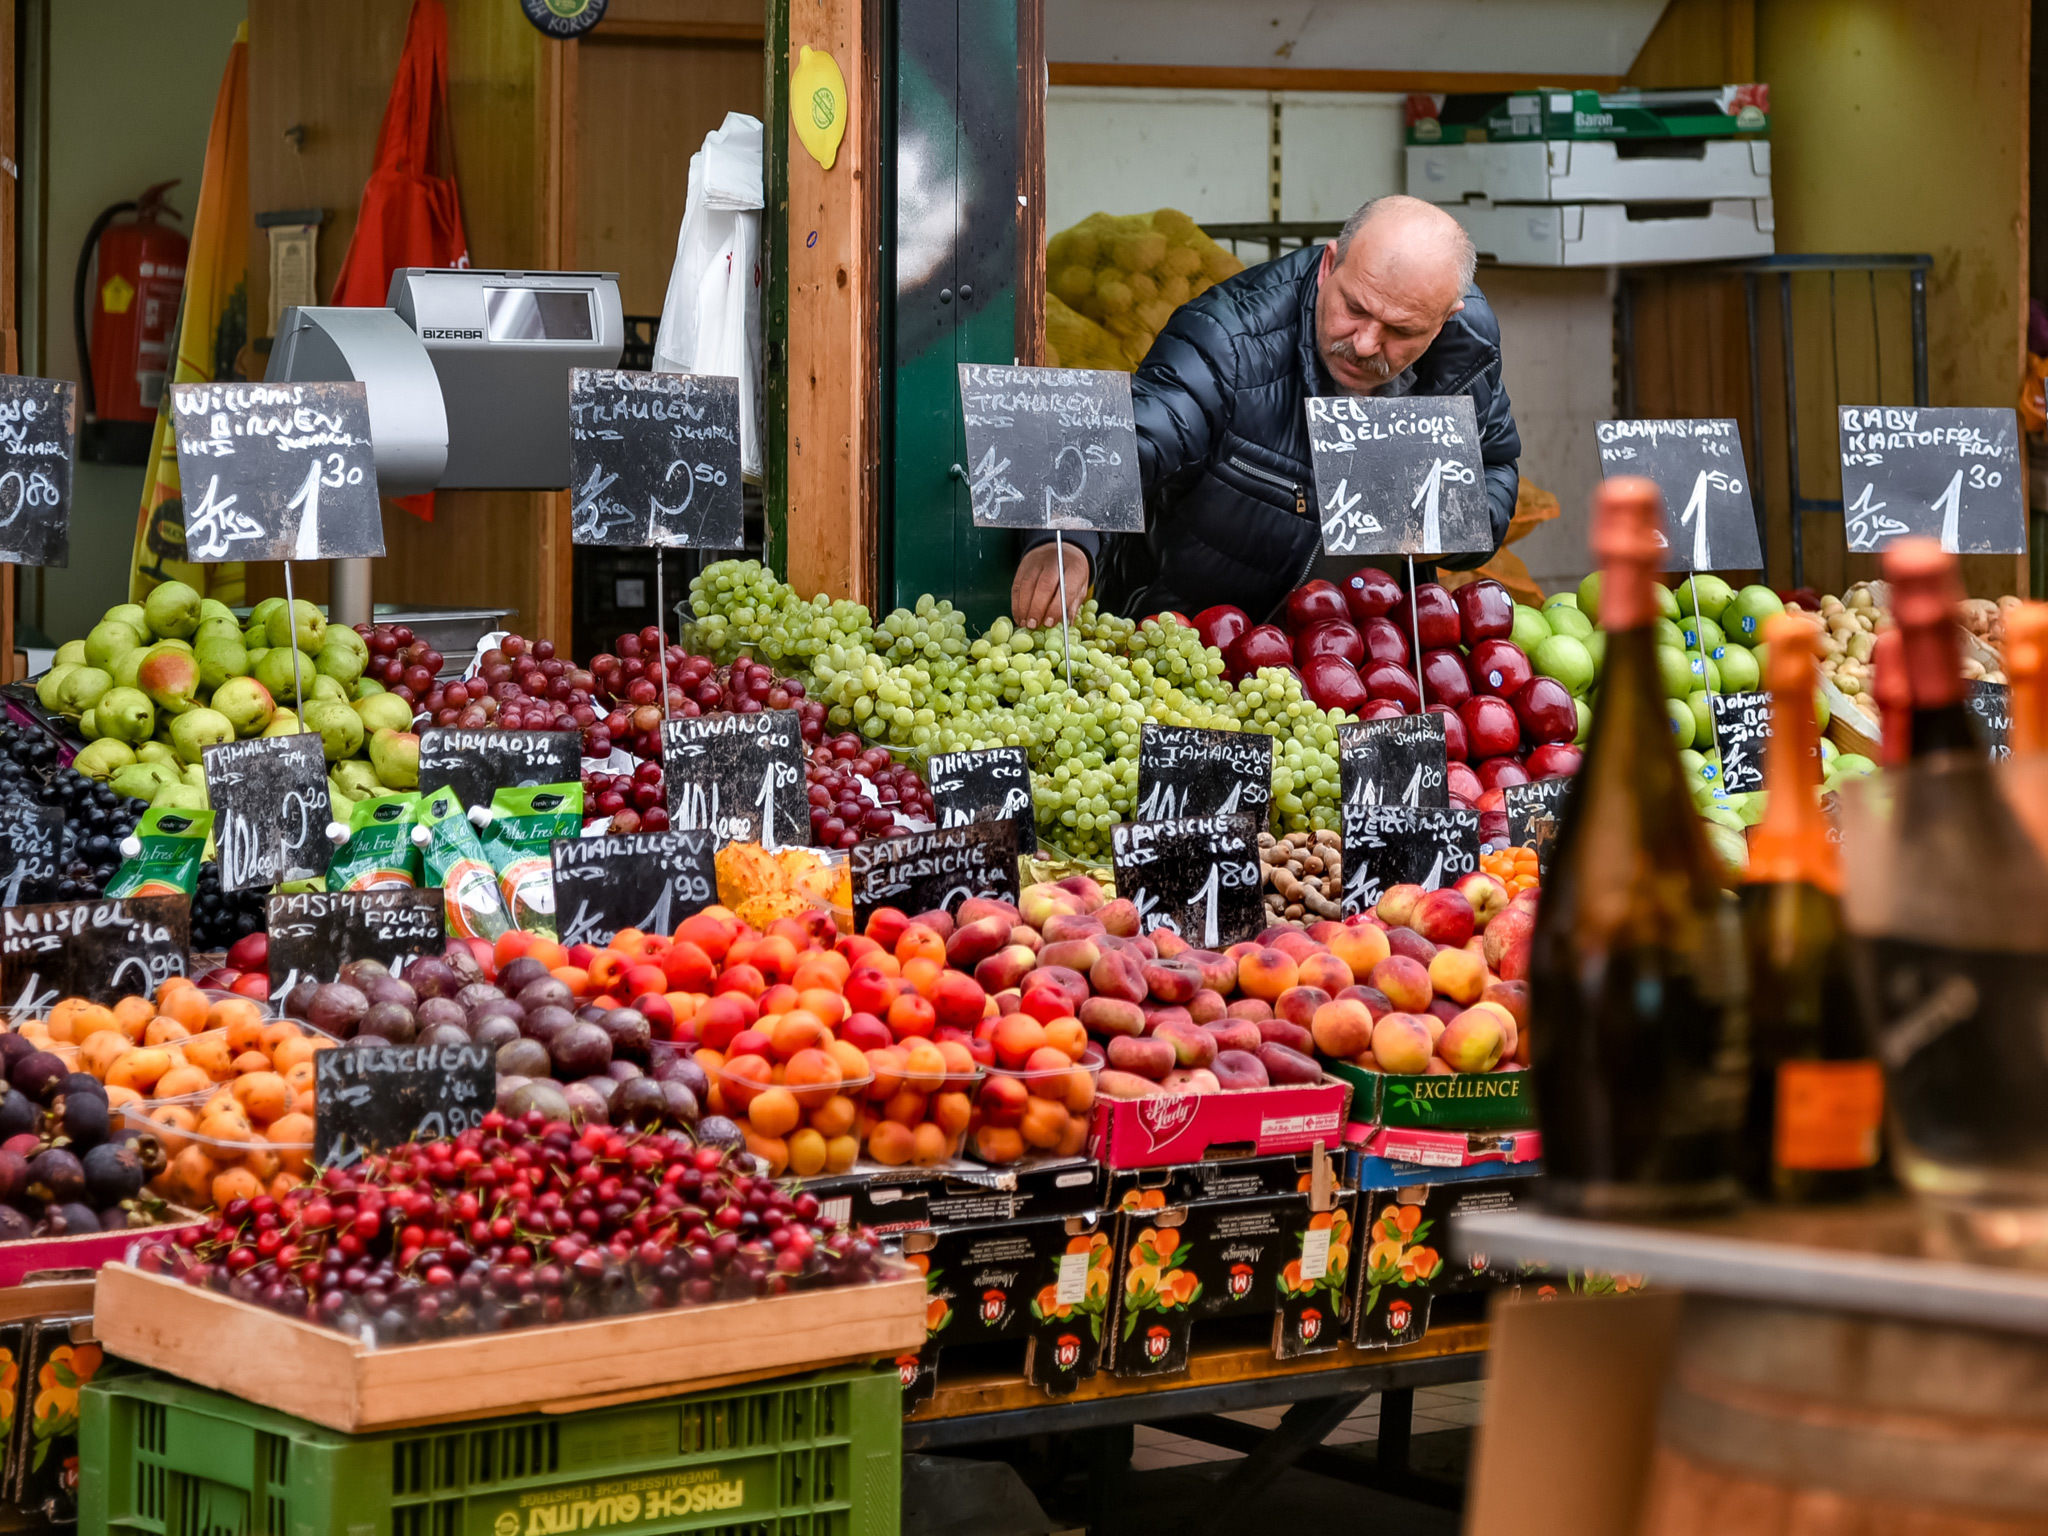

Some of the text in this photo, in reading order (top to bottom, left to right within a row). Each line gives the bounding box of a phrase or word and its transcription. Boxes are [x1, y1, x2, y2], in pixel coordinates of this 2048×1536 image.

[423, 329, 483, 341] BIZERBA
[1308, 397, 1370, 423] RED
[1843, 408, 1918, 432] BABY
[1414, 1080, 1520, 1099] EXCELLENCE
[645, 1479, 743, 1520] FRISCHE
